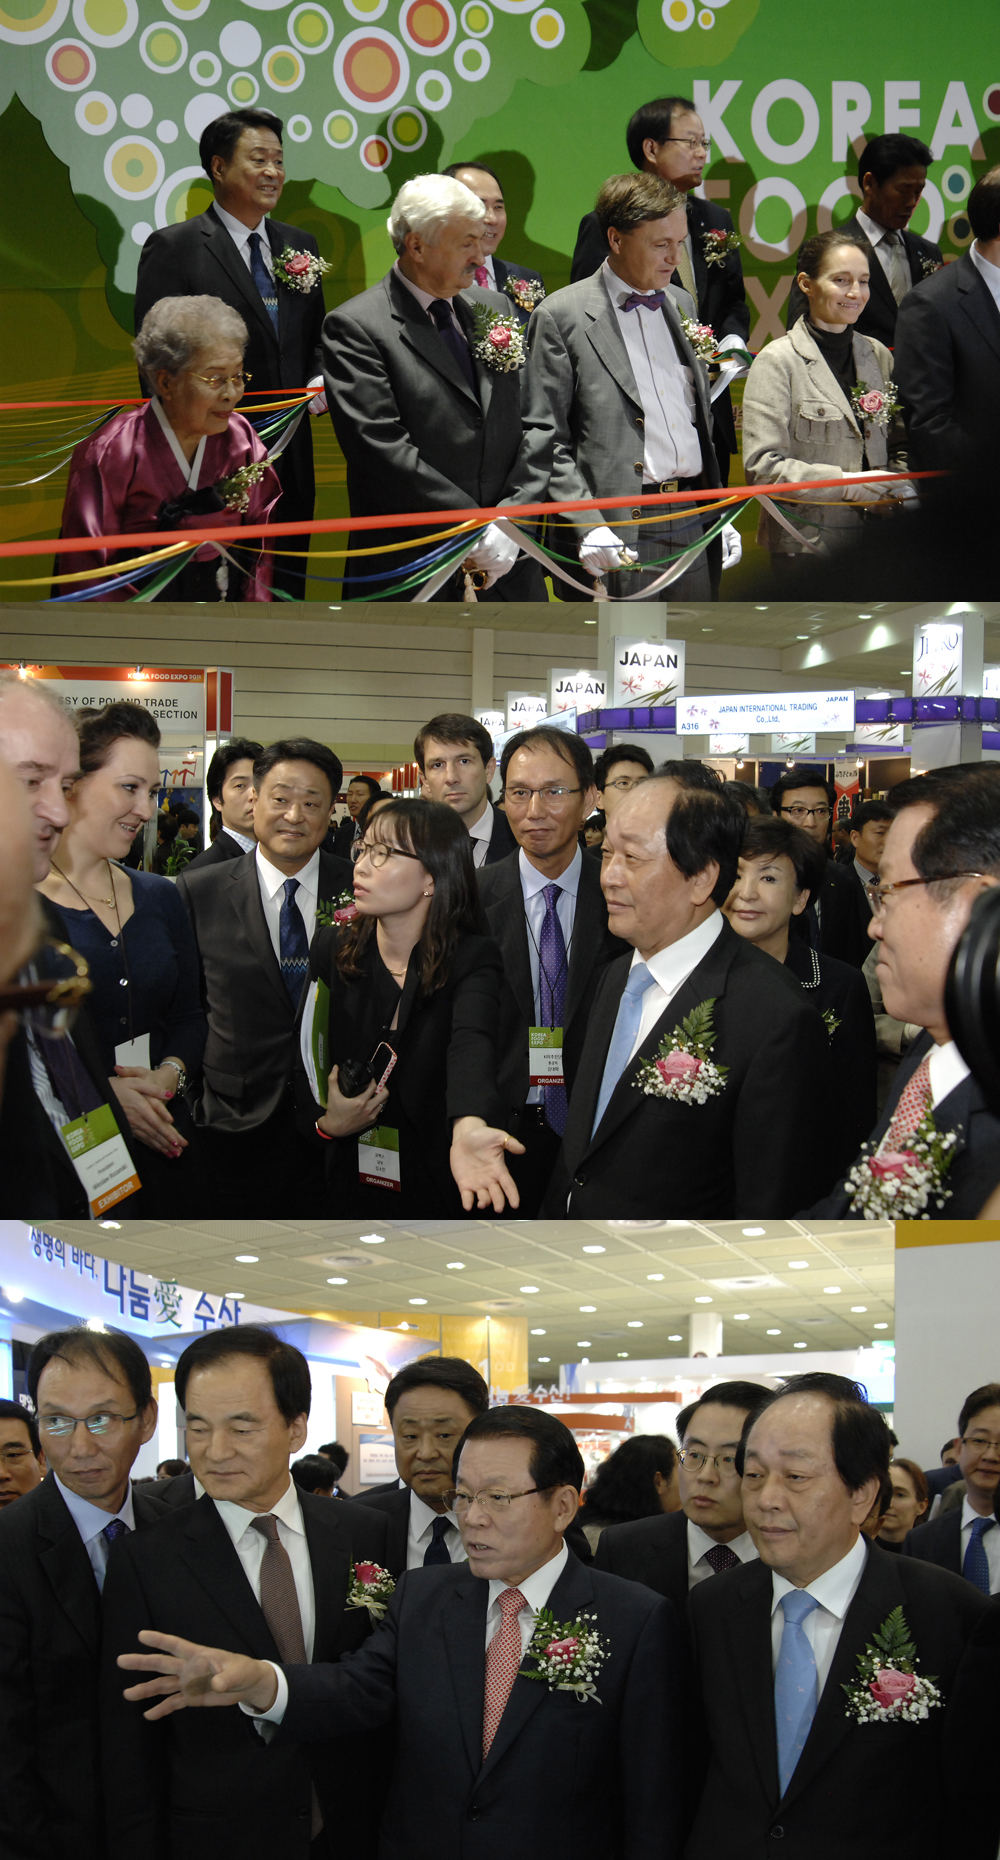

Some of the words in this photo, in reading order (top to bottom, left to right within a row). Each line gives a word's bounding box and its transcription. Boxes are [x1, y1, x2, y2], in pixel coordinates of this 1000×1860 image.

[693, 78, 987, 165] KOREA
[619, 651, 678, 669] JAPAN
[555, 681, 605, 695] JAPAN
[58, 697, 79, 705] SSY
[82, 697, 95, 705] OF
[144, 698, 179, 707] TRADE
[718, 705, 738, 713] JAPAN
[739, 704, 788, 713] INTERNATIONAL
[789, 703, 818, 711] TRADING
[152, 710, 198, 719] SECTION
[681, 722, 699, 731] A316
[365, 1176, 394, 1188] ORGANIZER
[97, 1180, 135, 1210] EXHIBITOR
[28, 1225, 66, 1268] 생명의
